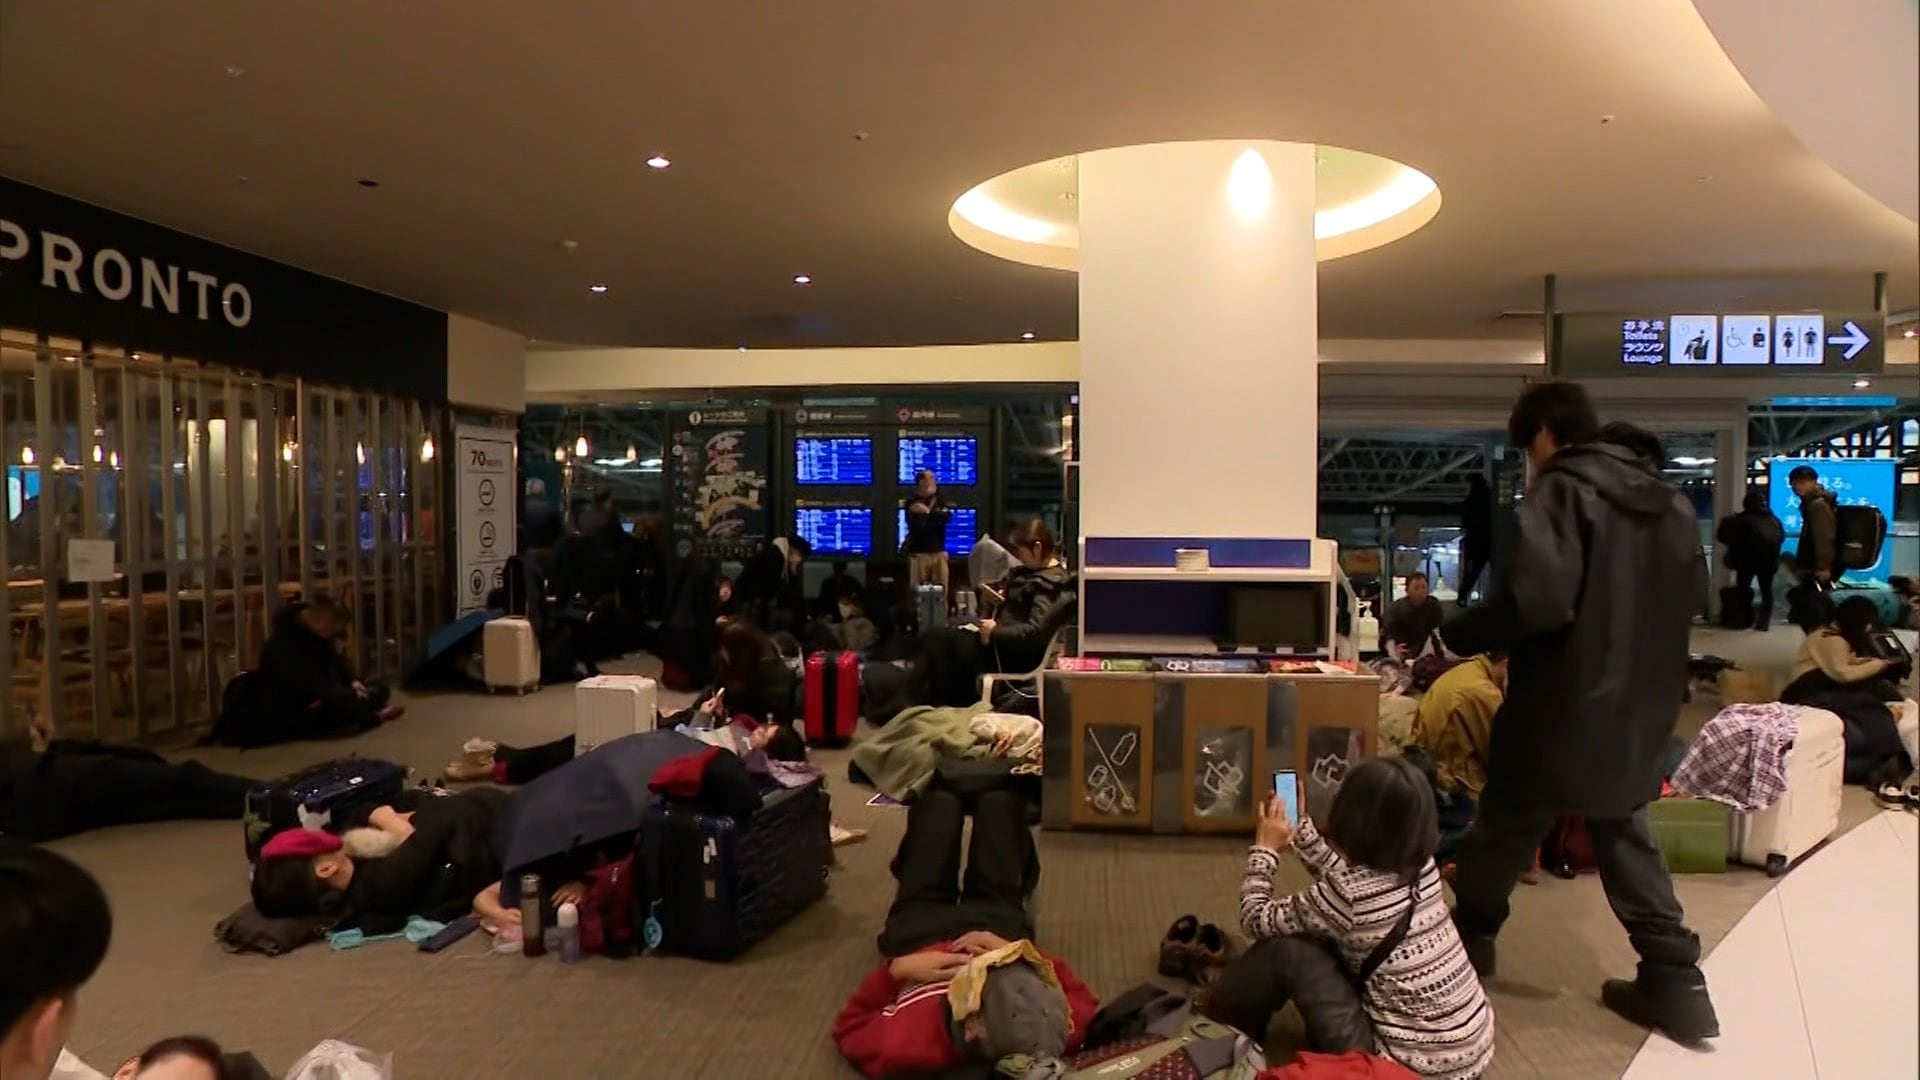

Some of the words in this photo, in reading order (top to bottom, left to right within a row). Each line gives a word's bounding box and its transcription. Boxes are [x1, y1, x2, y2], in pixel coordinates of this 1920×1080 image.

[0, 218, 252, 328] PRONTO
[1623, 353, 1663, 364] Lounge
[471, 449, 486, 466] 70
